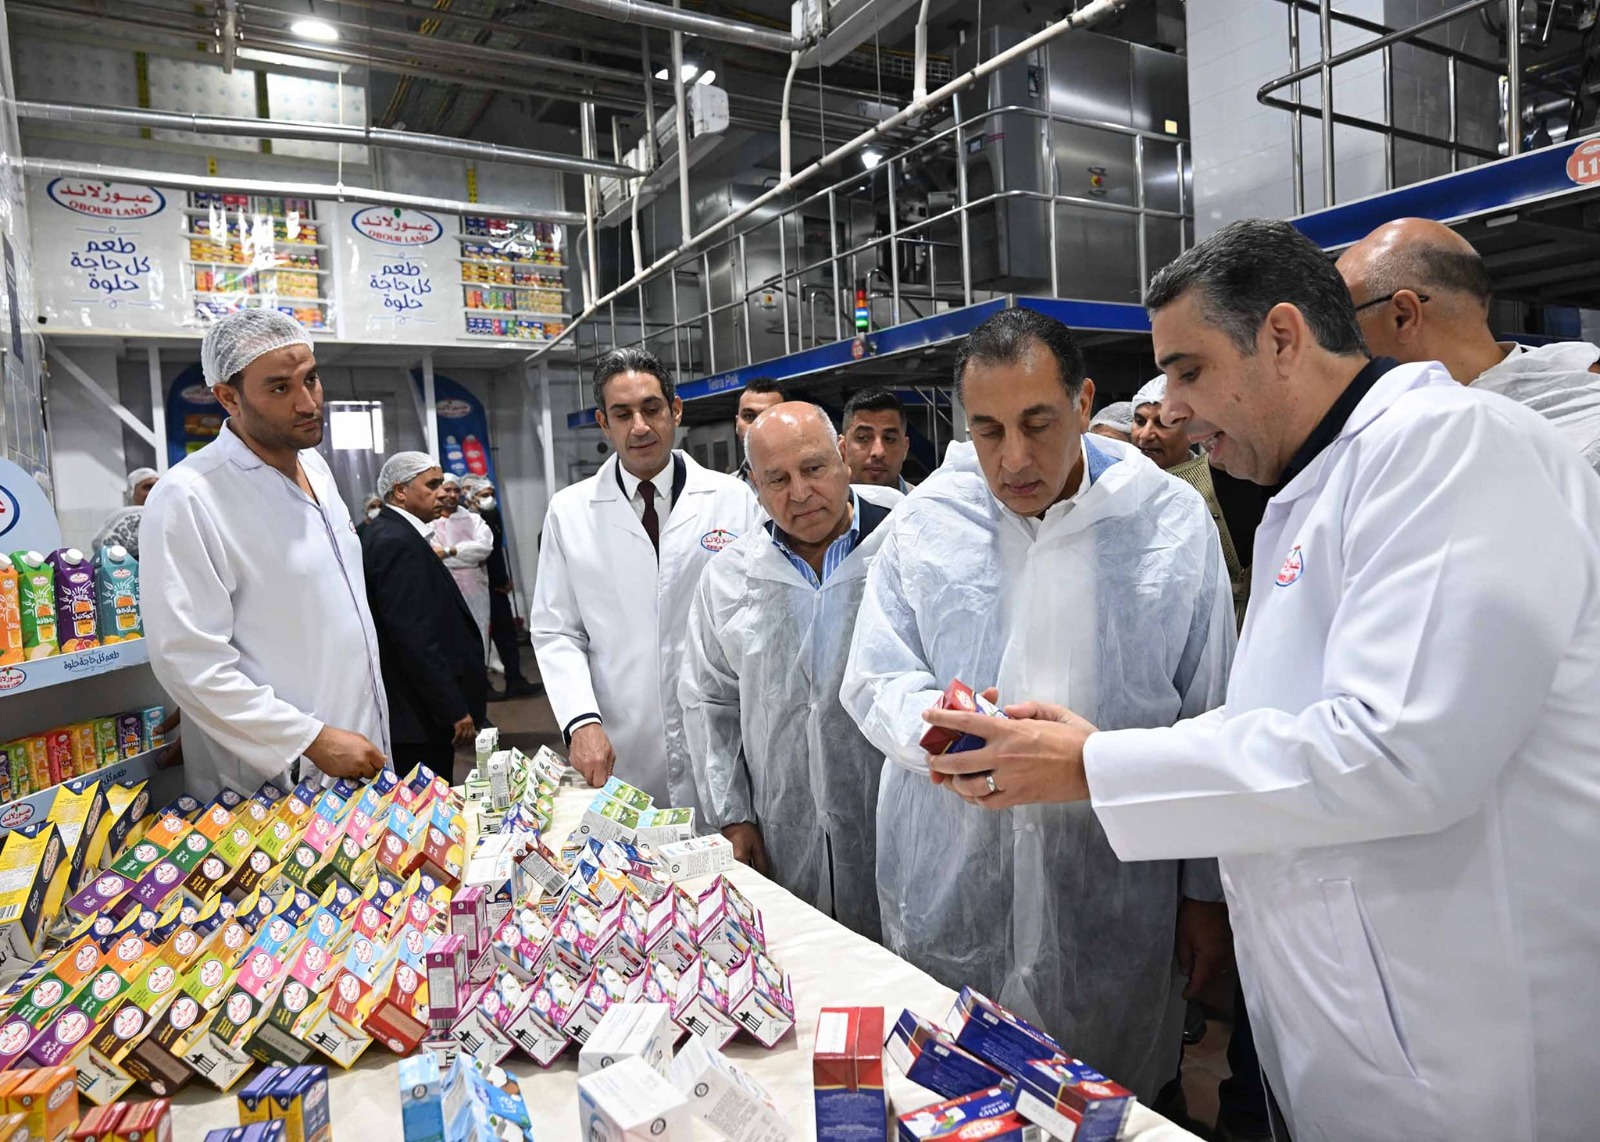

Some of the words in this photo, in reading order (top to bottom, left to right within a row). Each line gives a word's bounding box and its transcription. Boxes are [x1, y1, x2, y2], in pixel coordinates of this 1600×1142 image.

[60, 183, 154, 207] عبورلاند
[69, 200, 113, 216] OBOUR
[115, 204, 148, 217] LAND
[361, 213, 434, 235] عبورلاند
[85, 237, 137, 254] طعم
[368, 229, 402, 243] OBOUR
[403, 233, 430, 244] LAND
[70, 252, 123, 271] حاجة
[125, 256, 151, 276] كل
[382, 262, 420, 276] طعم
[88, 272, 140, 294] حلوة
[370, 274, 410, 292] حاجة
[411, 277, 432, 296] كل
[383, 293, 424, 313] حلوة
[725, 374, 740, 387] Pak
